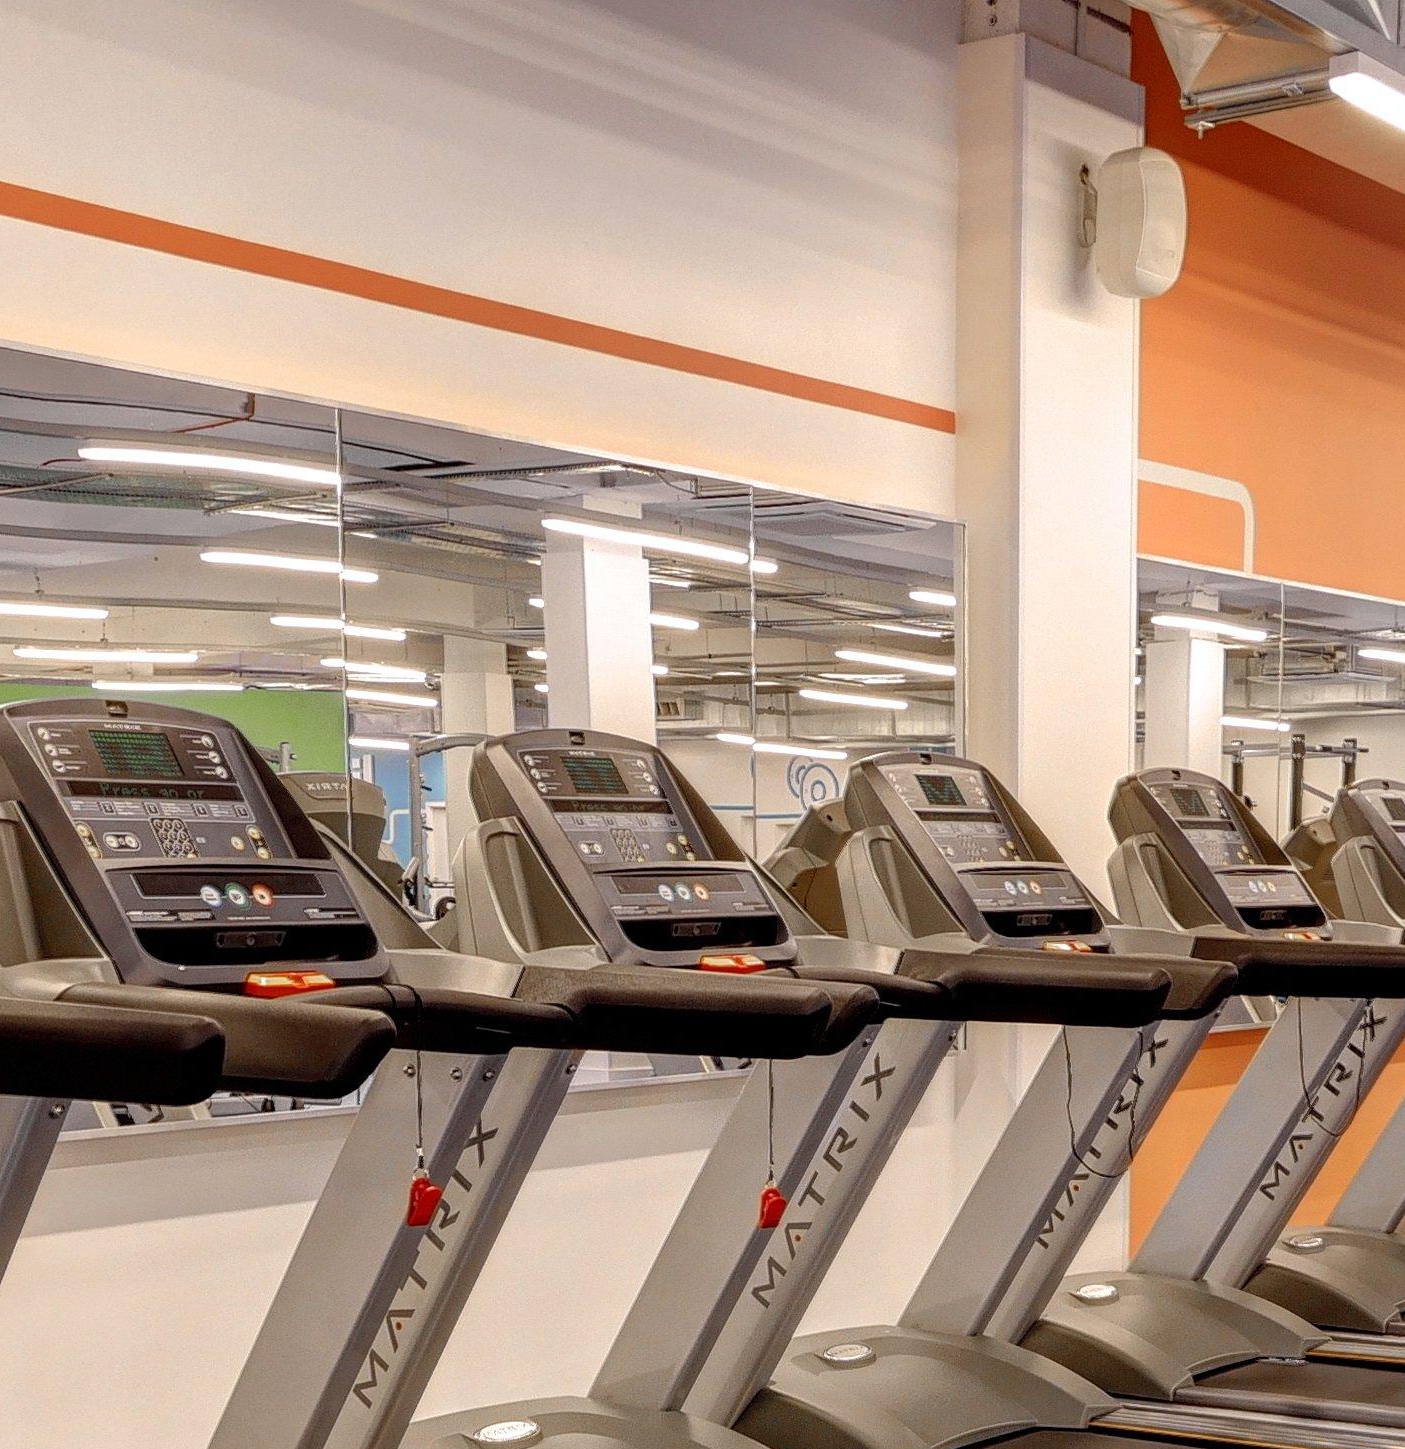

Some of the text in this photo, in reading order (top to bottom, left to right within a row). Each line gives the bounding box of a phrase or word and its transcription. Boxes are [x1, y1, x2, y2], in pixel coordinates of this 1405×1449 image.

[751, 1052, 895, 1309] MATRIX
[1258, 1011, 1387, 1201] MATRIX
[353, 1118, 498, 1409] MATRIX
